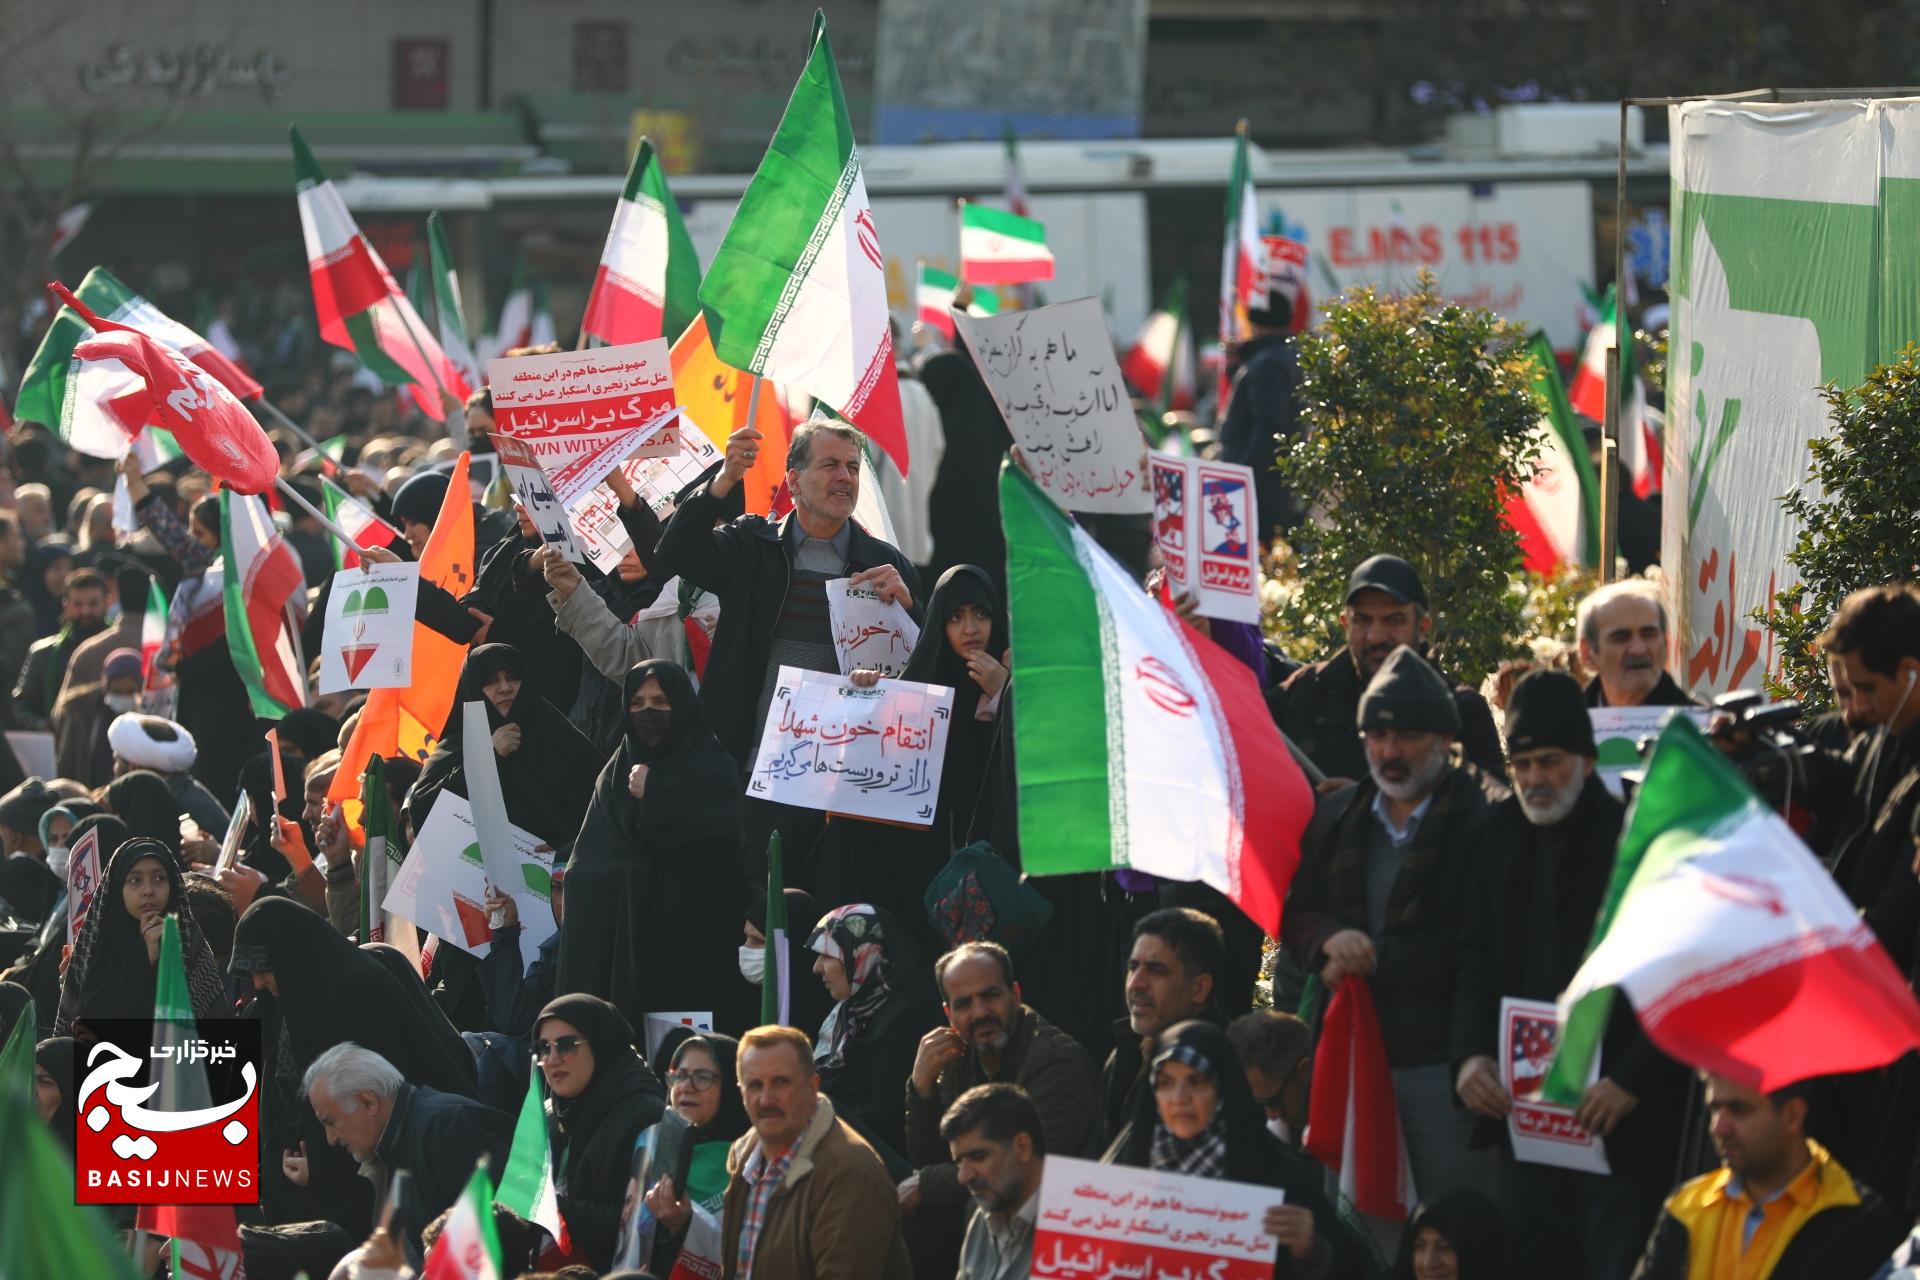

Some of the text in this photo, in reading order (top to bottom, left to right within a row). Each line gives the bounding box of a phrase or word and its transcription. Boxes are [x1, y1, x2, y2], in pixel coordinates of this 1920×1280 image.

[1457, 223, 1520, 262] 115
[512, 371, 542, 383] منطقه
[543, 368, 559, 383] این
[561, 368, 573, 381] در
[573, 367, 586, 378] هم
[587, 363, 598, 375] ها
[599, 360, 647, 376] صهیونیست
[495, 372, 668, 403] مثل سگ زنجیری استکبار عمل می کنند
[848, 621, 890, 651] خون
[778, 699, 935, 757] انتقام خون شهدا
[889, 757, 920, 793] از
[905, 758, 932, 796] را
